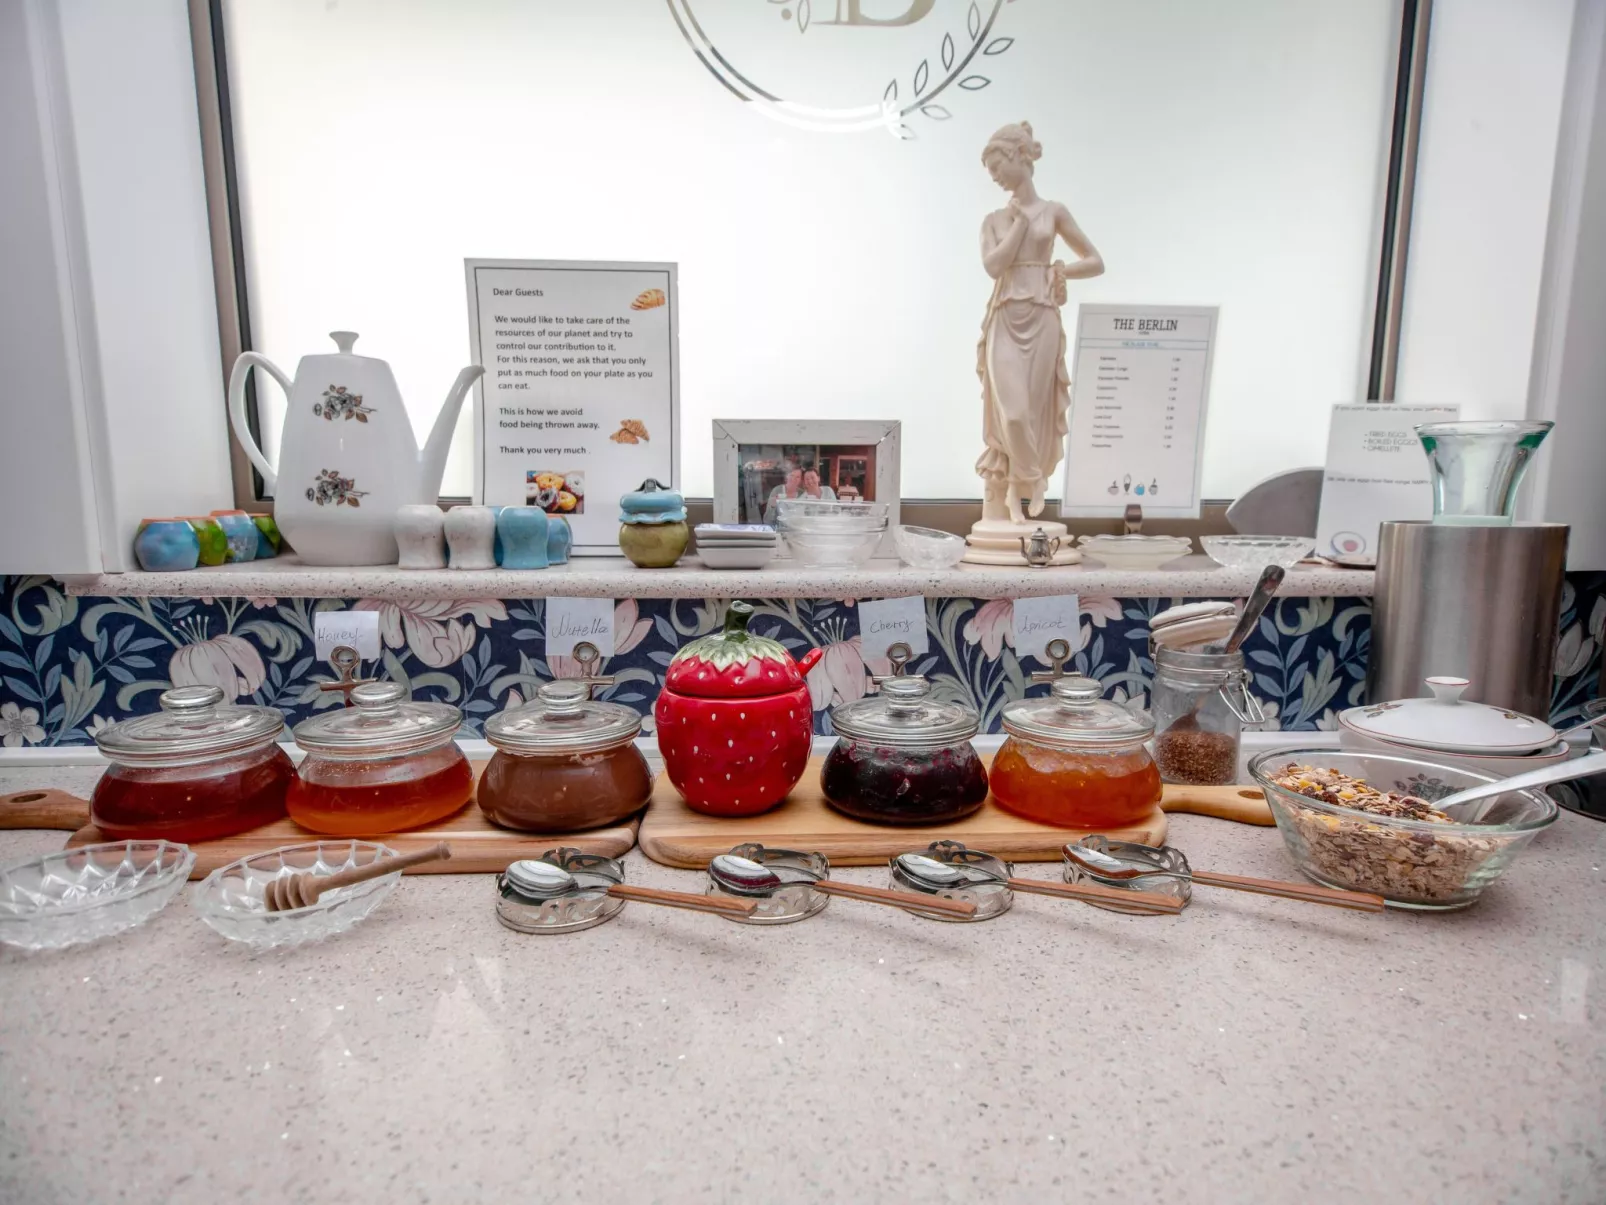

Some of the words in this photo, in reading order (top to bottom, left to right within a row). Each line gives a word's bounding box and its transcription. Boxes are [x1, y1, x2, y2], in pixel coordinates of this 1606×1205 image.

[493, 288, 513, 296] Dear
[515, 288, 544, 296] Guests
[538, 316, 553, 324] like
[566, 316, 584, 324] take
[1113, 318, 1135, 331] THE
[1138, 319, 1178, 331] BERLIN
[537, 329, 546, 337] of
[564, 330, 590, 338] planet
[610, 331, 622, 339] try
[544, 343, 595, 351] contribution
[512, 355, 528, 363] this
[576, 356, 590, 364] ask
[592, 356, 609, 364] that
[611, 358, 626, 366] you
[628, 357, 646, 366] only
[497, 369, 511, 378] put
[583, 370, 601, 379] your
[604, 369, 625, 378] plate
[638, 371, 653, 379] you
[526, 408, 544, 416] how
[560, 408, 583, 416] avoid
[499, 420, 518, 428] food
[520, 420, 543, 430] being
[577, 422, 600, 430] away.
[500, 446, 524, 454] Thank
[563, 446, 586, 454] much
[870, 619, 914, 633] Cherry
